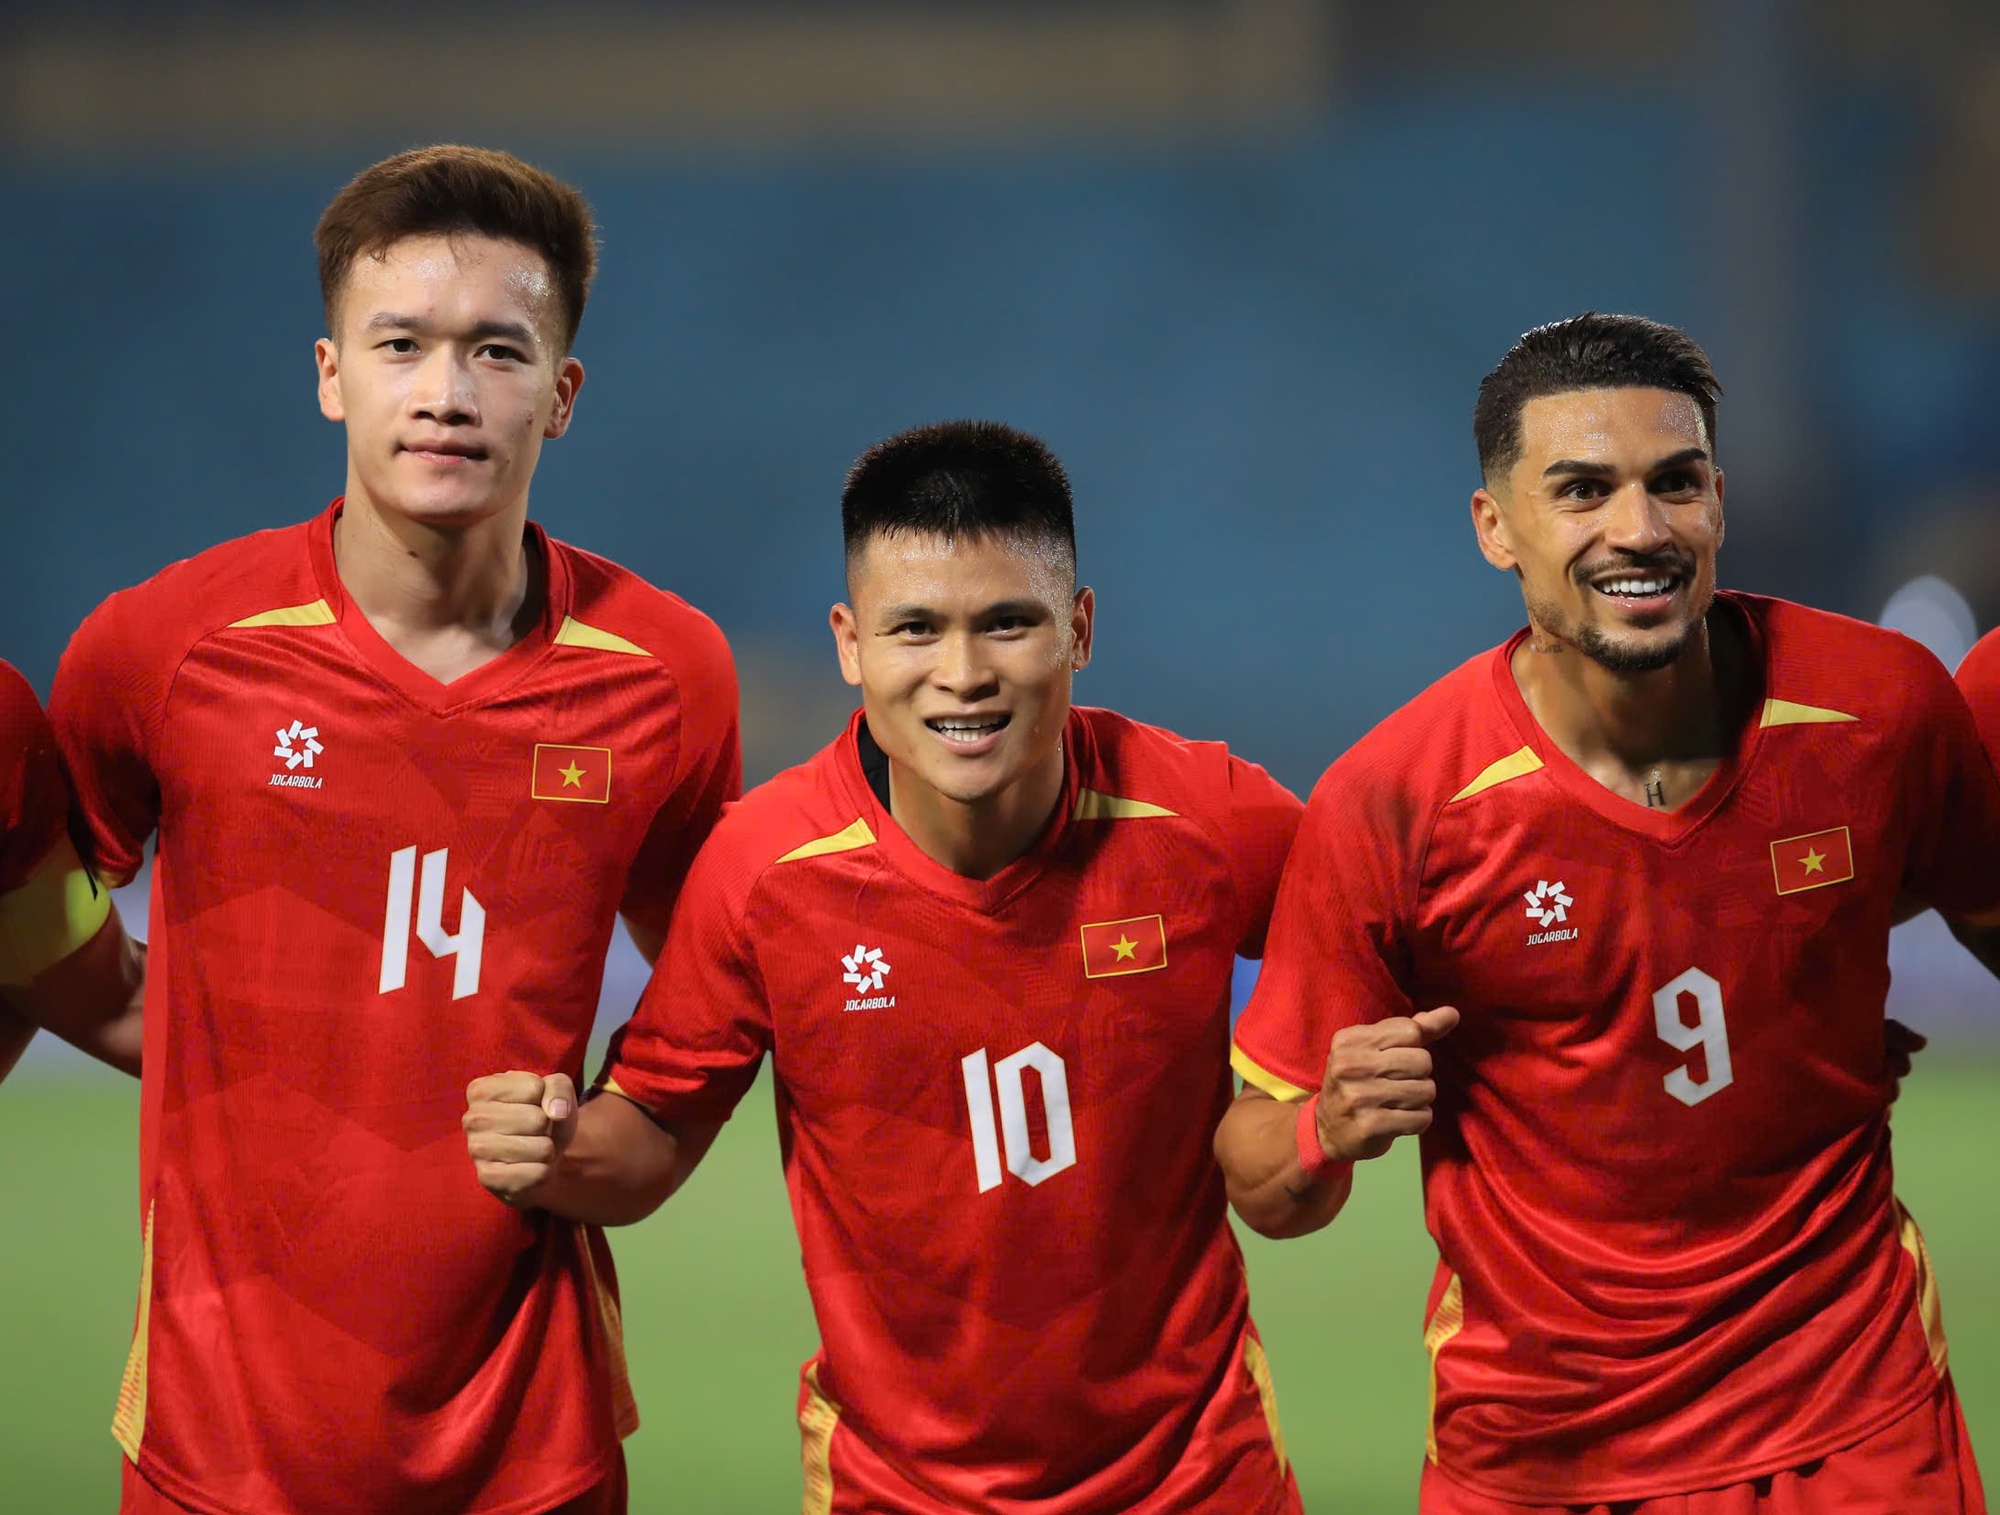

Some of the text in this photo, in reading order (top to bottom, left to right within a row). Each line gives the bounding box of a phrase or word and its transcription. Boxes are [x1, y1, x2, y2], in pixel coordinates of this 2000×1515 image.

[268, 774, 323, 789] JOGARBOLA
[379, 845, 486, 1000] 14
[1526, 928, 1578, 946] JOGARBOLA
[843, 996, 896, 1012] JOGARBOLA
[1653, 967, 1733, 1106] 9
[962, 1042, 1077, 1193] 10
